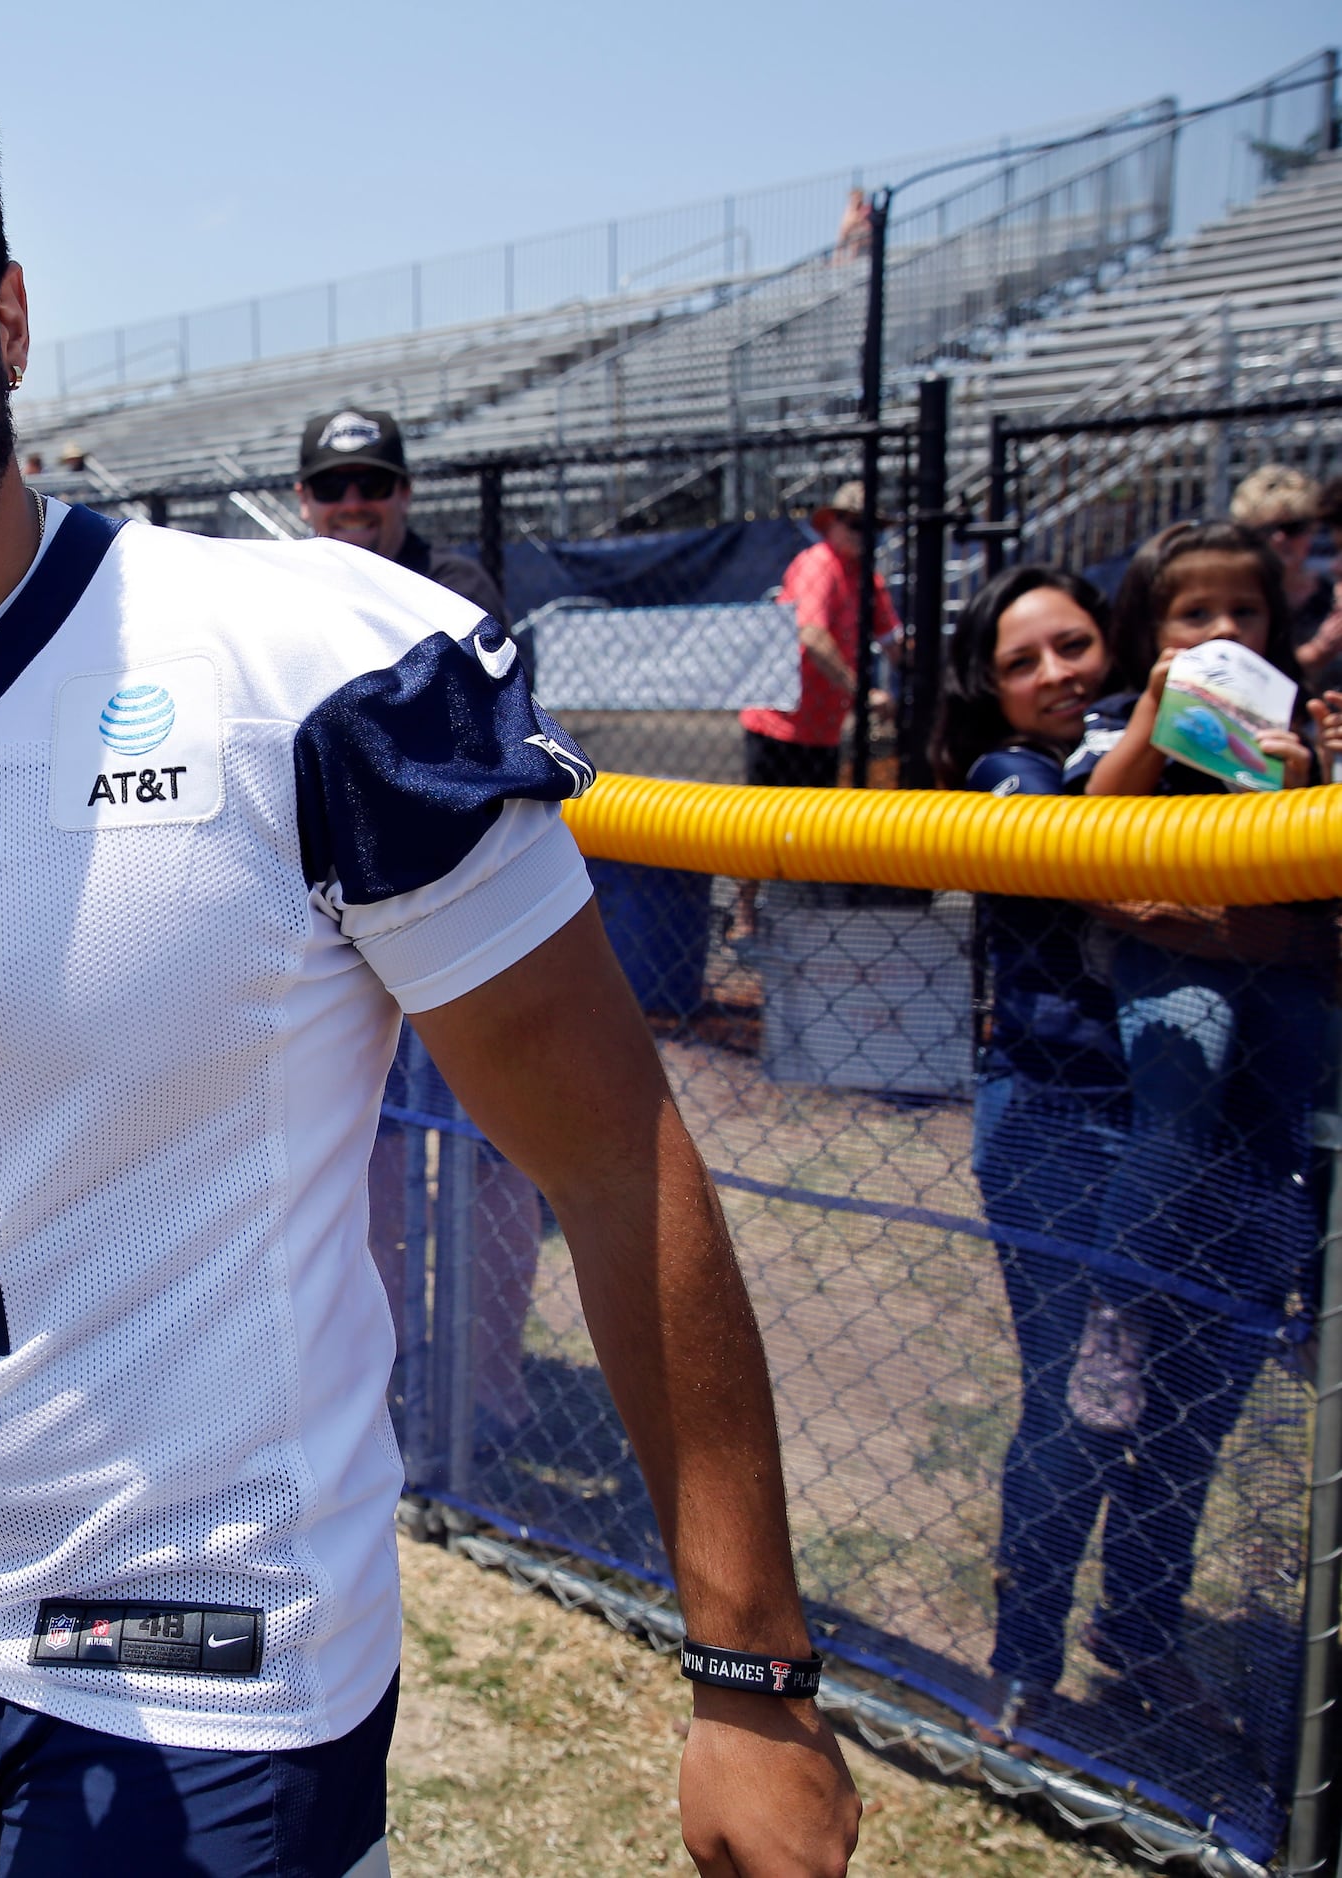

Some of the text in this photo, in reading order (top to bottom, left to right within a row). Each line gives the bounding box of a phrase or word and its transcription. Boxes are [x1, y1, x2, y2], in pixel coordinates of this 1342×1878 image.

[87, 766, 187, 807] AT&T
[684, 1651, 704, 1673] WIN
[708, 1658, 765, 1683] GAMES
